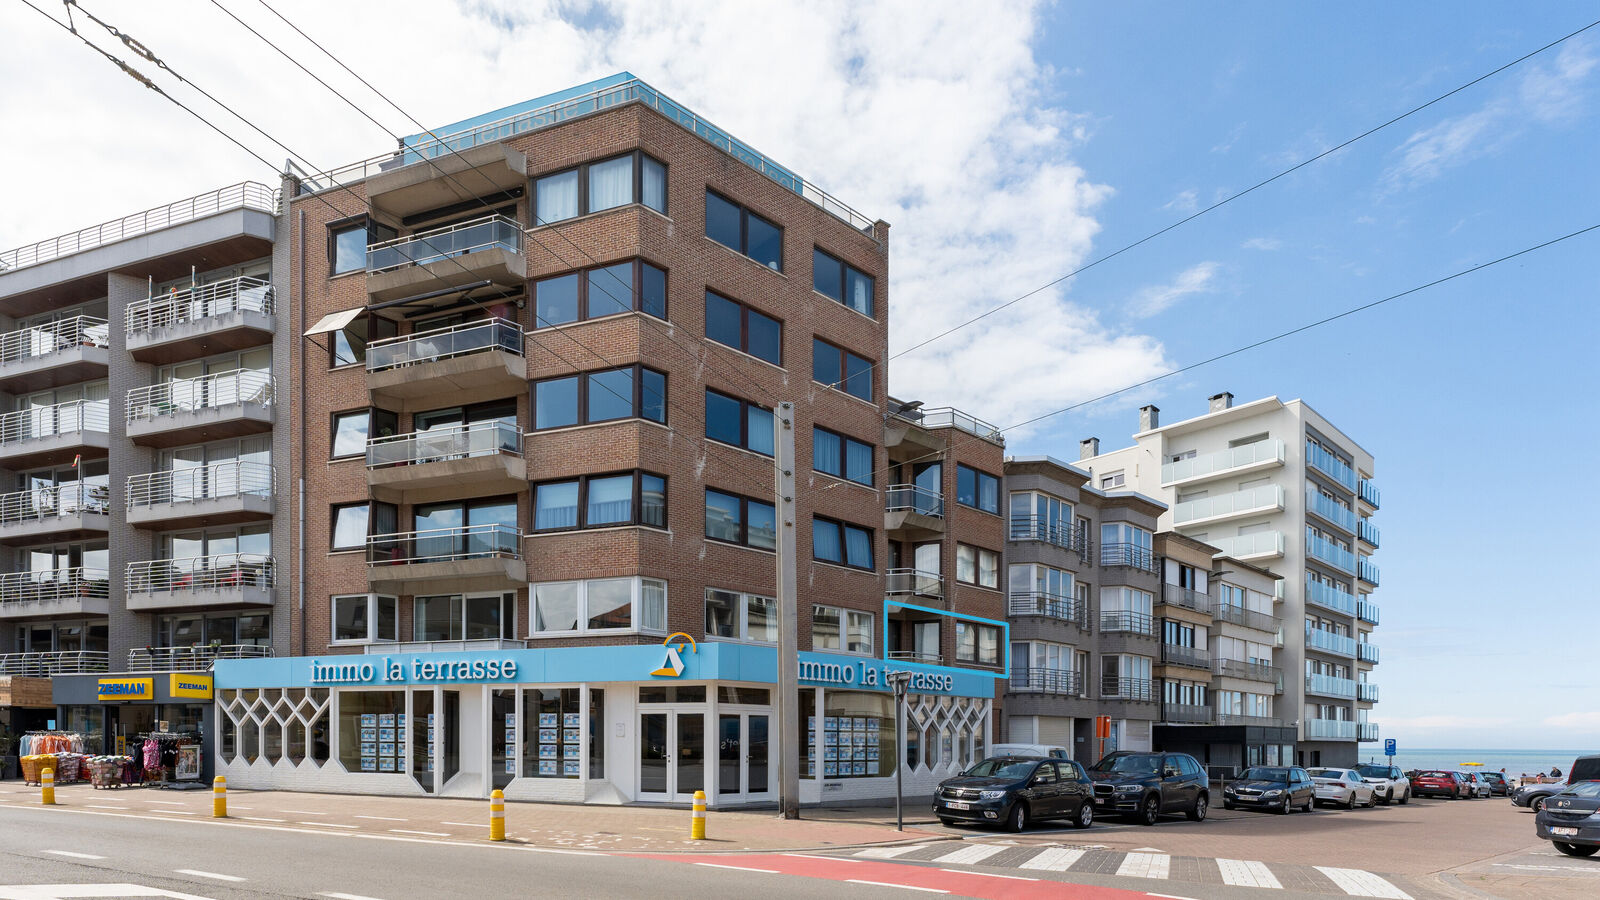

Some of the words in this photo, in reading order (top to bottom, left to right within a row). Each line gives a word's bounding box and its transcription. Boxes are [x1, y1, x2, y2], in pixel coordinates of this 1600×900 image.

[309, 659, 375, 683] immo
[382, 656, 404, 682] la
[411, 657, 517, 681] terrasse
[859, 660, 879, 686] la
[882, 665, 953, 692] trasse
[98, 682, 145, 695] ZEEMAN
[178, 682, 208, 691] ZEEMAN
[1386, 740, 1394, 749] P
